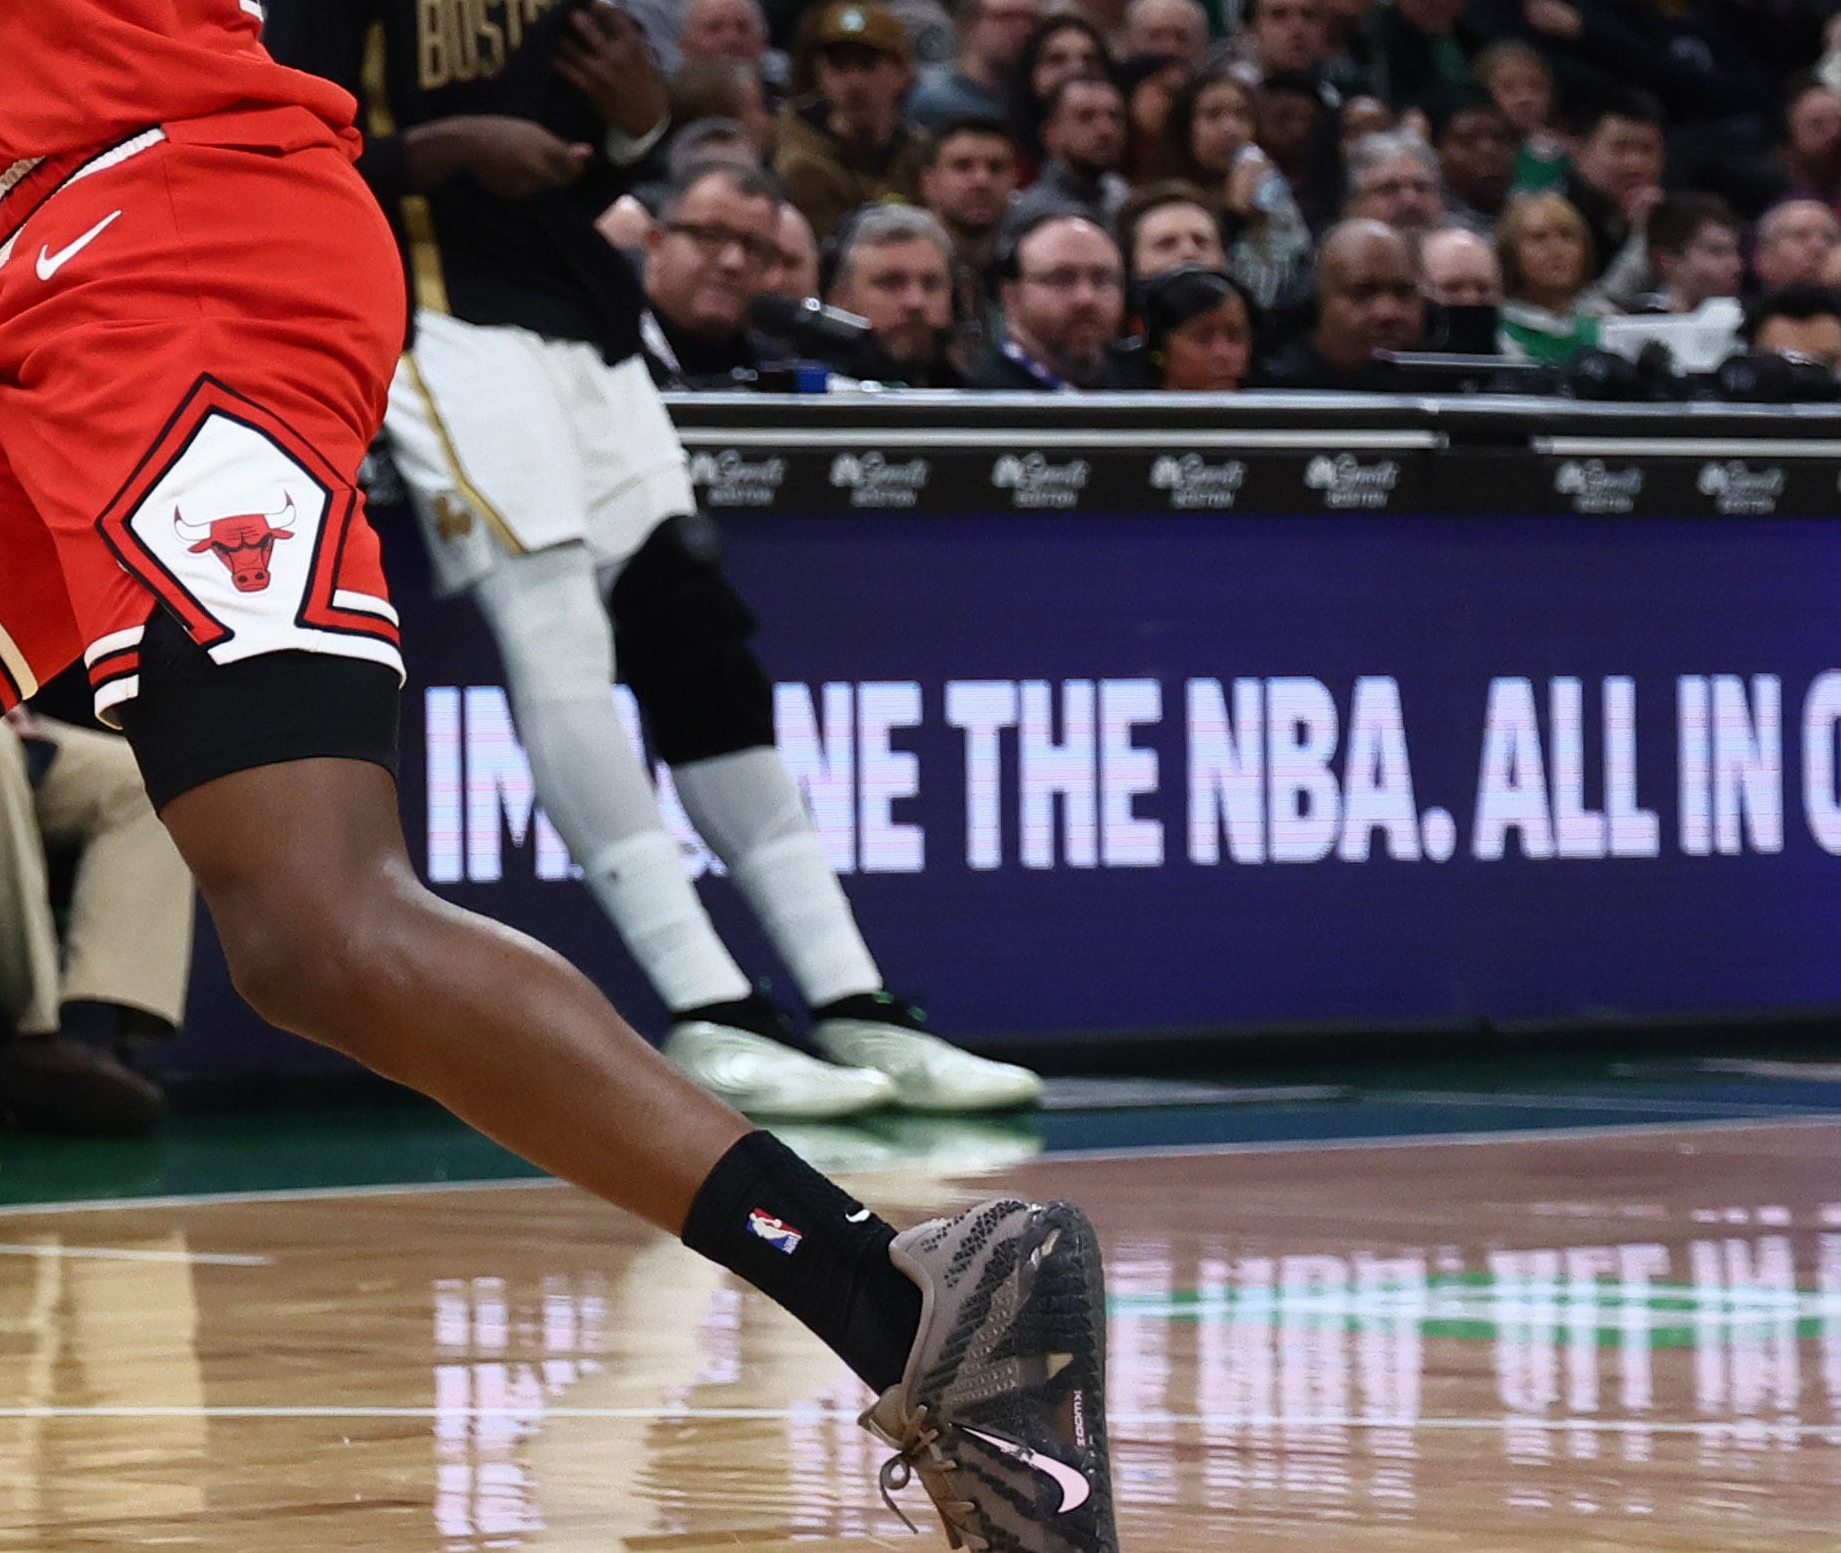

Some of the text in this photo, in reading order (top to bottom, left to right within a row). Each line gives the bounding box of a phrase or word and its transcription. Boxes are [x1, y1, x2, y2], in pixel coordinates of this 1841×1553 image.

[424, 678, 925, 884] IMNE
[945, 676, 1165, 871] THE
[1186, 673, 1458, 867] NBA.
[1472, 674, 1660, 861] ALL
[1677, 673, 1783, 855] IN
